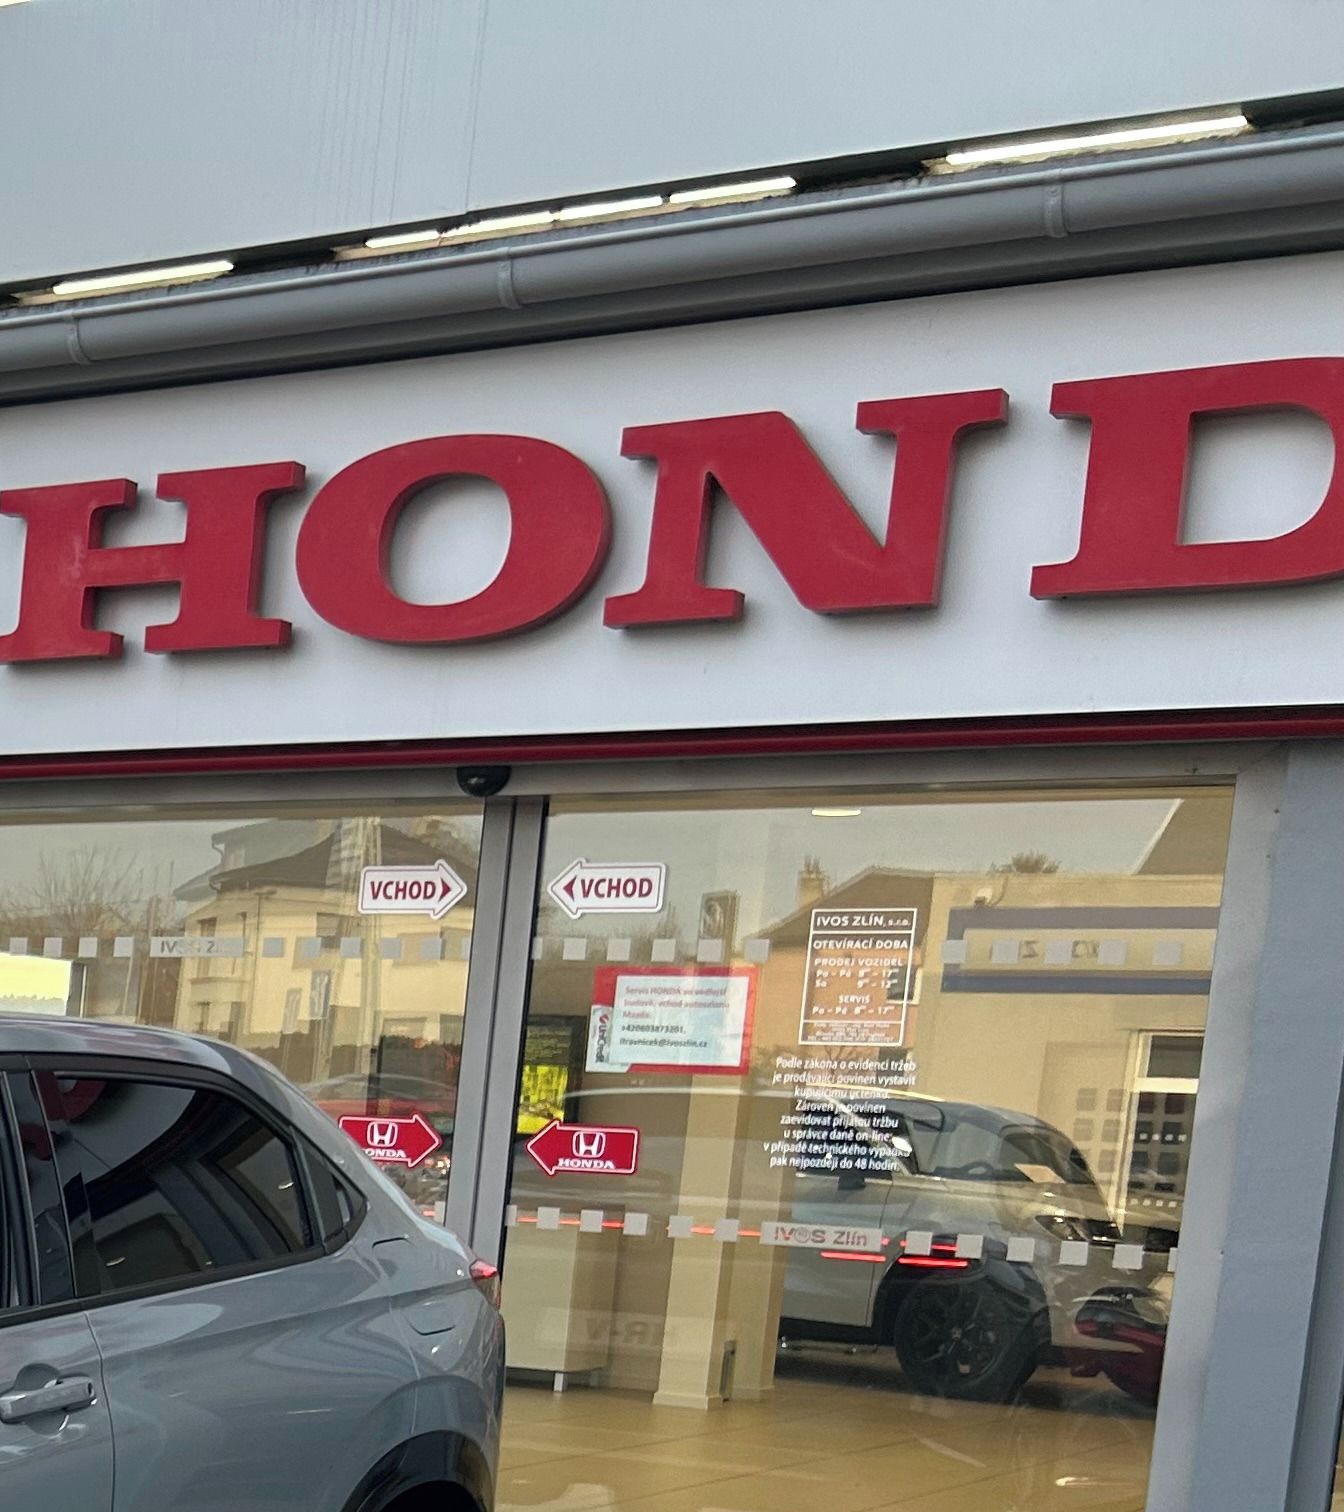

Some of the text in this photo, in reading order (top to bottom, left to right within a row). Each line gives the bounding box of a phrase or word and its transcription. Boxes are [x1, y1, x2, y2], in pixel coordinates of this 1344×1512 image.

[370, 880, 436, 900] VCHOD
[579, 877, 653, 898] VCHOD
[816, 916, 849, 927] IVOS
[852, 913, 886, 928] ZLÍN,
[813, 938, 908, 950] OTEVÍRACÍ DOBA
[814, 958, 903, 967] PRODEJ VOZIDEL
[838, 995, 870, 1004] SERVIS
[776, 1056, 917, 1072] Podle zákona o evidenci tržeb
[772, 1072, 782, 1086] je
[837, 1073, 876, 1085] povinen
[878, 1074, 916, 1087] vystavit
[846, 1101, 886, 1115] povinen
[780, 1114, 831, 1127] zaevidovat
[872, 1117, 899, 1128] tržbu
[792, 1129, 827, 1142] správce
[829, 1129, 854, 1140] daně
[362, 1148, 407, 1158] ONDA
[771, 1140, 807, 1155] případě
[807, 1142, 867, 1156] technického
[557, 1157, 616, 1169] HONDA
[770, 1155, 787, 1167] pak
[840, 1157, 853, 1169] do
[854, 1158, 867, 1169] 48
[833, 1230, 868, 1247] Zlín
